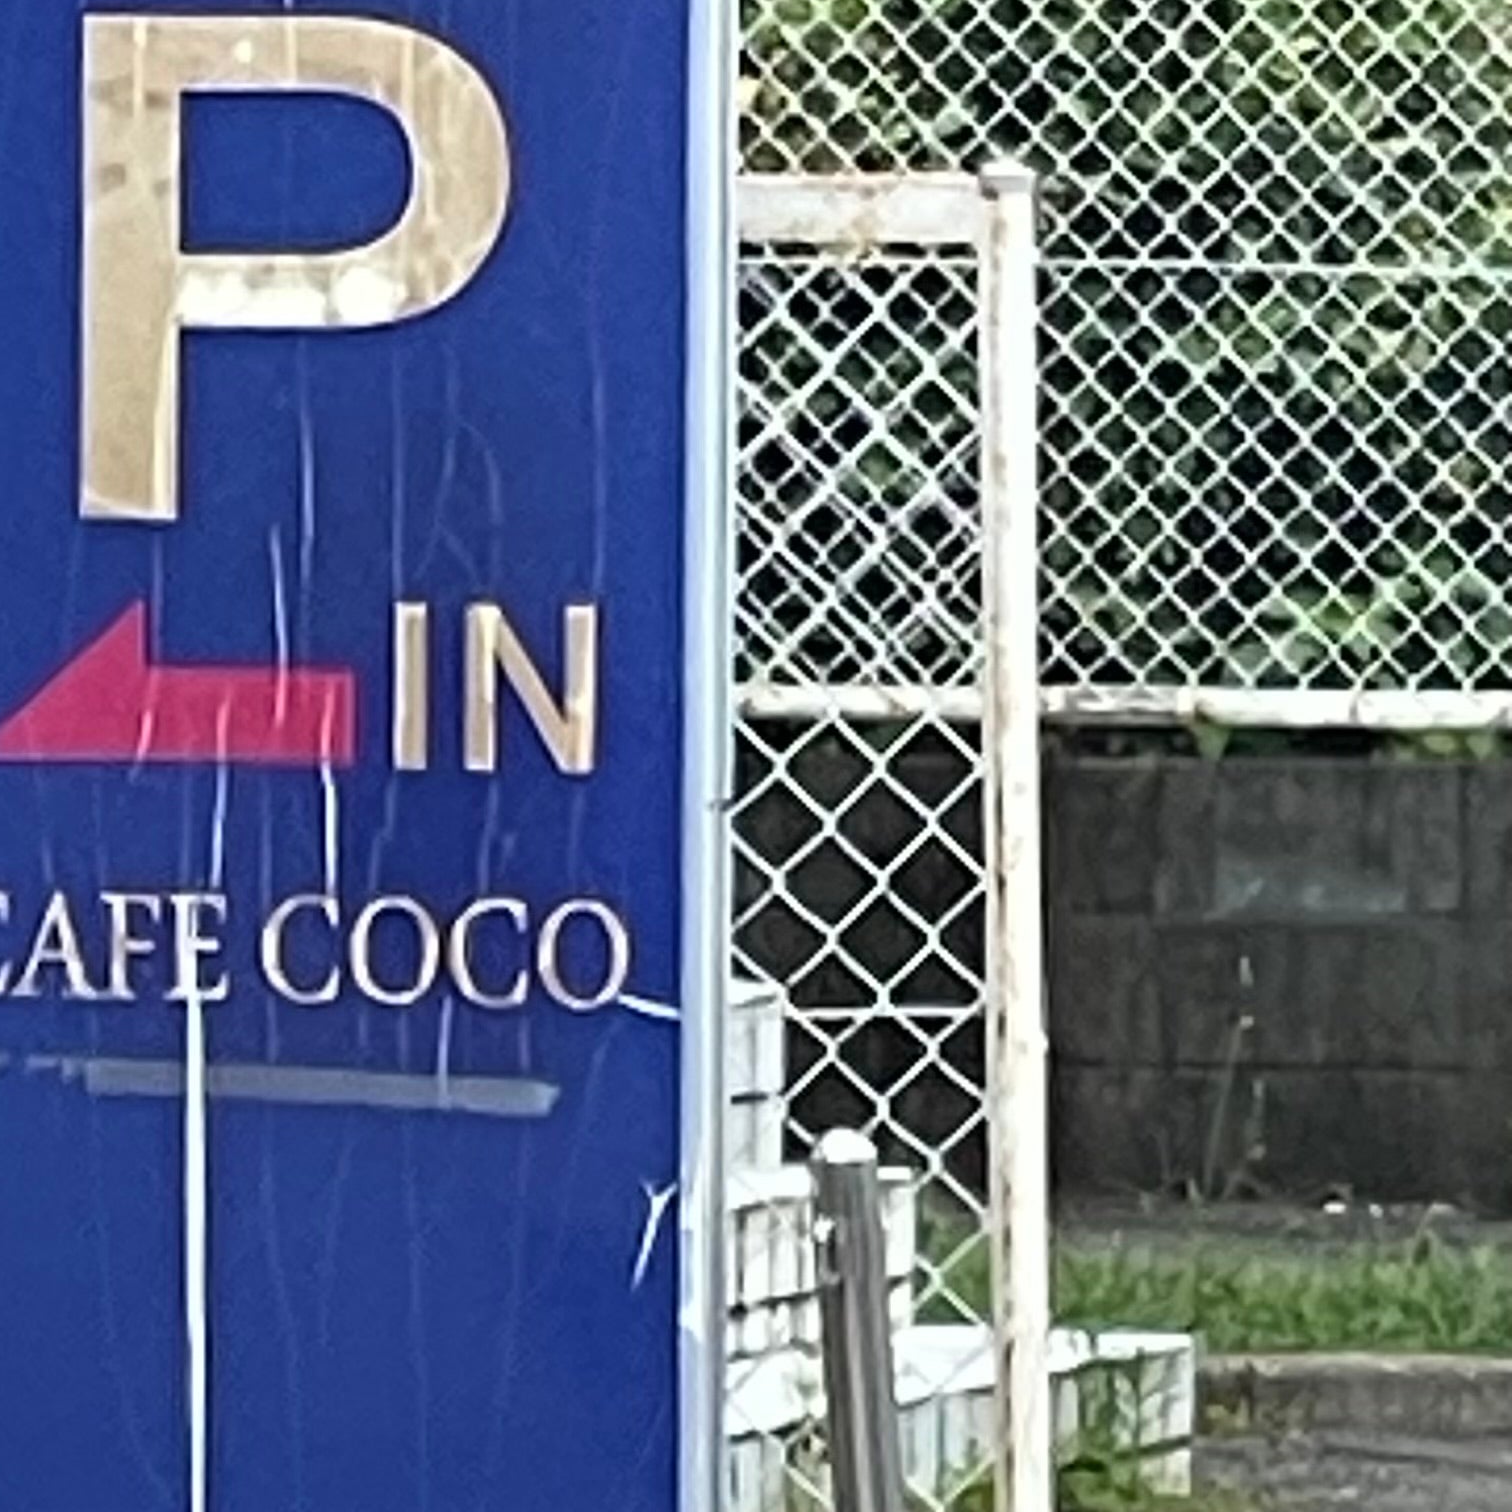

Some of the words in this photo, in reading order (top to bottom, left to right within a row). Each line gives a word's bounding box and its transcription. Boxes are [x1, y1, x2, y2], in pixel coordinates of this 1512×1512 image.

[78, 12, 512, 522] P
[392, 600, 598, 775] IN
[261, 895, 631, 1009] COCO
